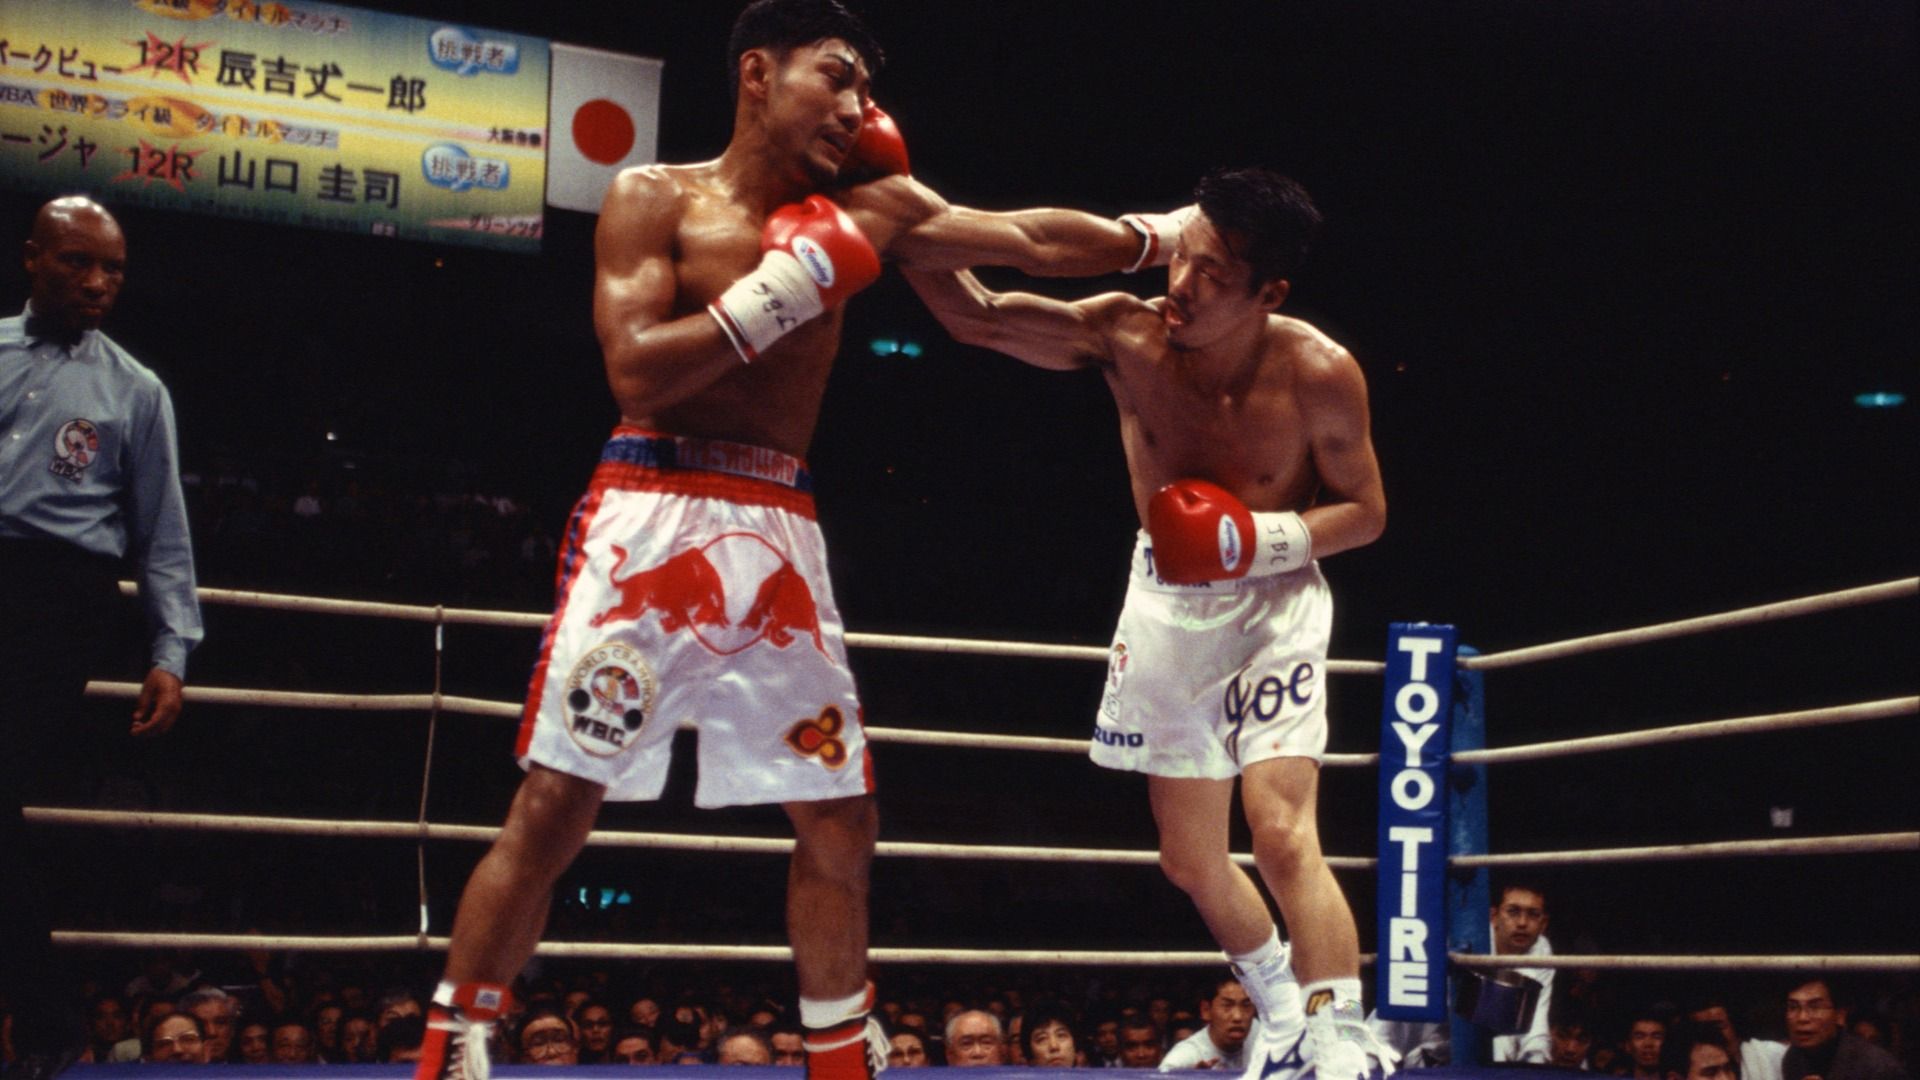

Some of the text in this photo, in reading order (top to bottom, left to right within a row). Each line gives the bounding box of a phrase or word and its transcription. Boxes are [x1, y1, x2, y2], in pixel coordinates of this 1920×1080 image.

[138, 40, 199, 74] 12R
[437, 38, 504, 68] 挑戦者
[129, 147, 193, 181] 12R
[431, 155, 500, 184] 挑戦者
[1267, 523, 1289, 567] JBC
[569, 650, 609, 688] WORLD
[573, 714, 625, 747] WBC
[1387, 636, 1443, 1008] TOYO TIRE
